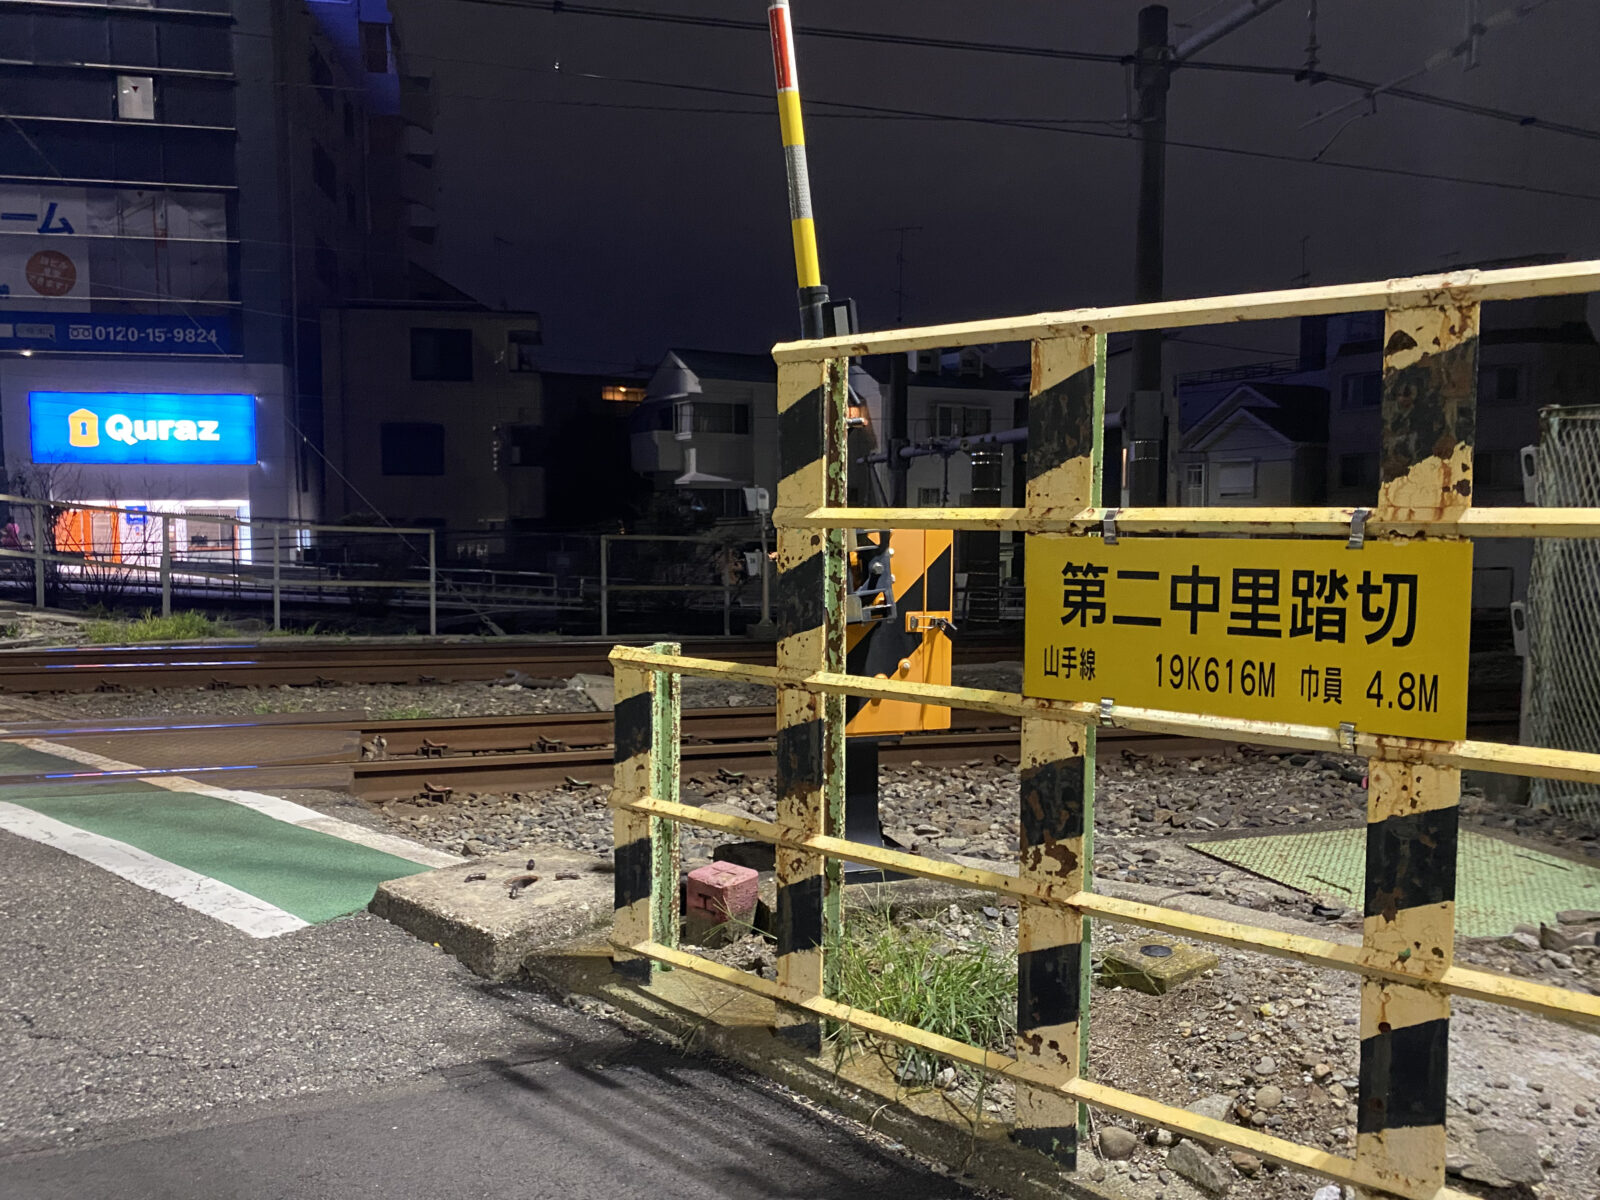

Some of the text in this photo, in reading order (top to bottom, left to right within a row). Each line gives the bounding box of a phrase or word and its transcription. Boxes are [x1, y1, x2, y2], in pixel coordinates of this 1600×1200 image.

[95, 326, 217, 343] 0120-15-9824
[105, 414, 220, 446] Quraz
[1061, 561, 1419, 648] 第二中里踏切
[1044, 645, 1439, 713] 山手線 19K616M 巾員 4.8M
